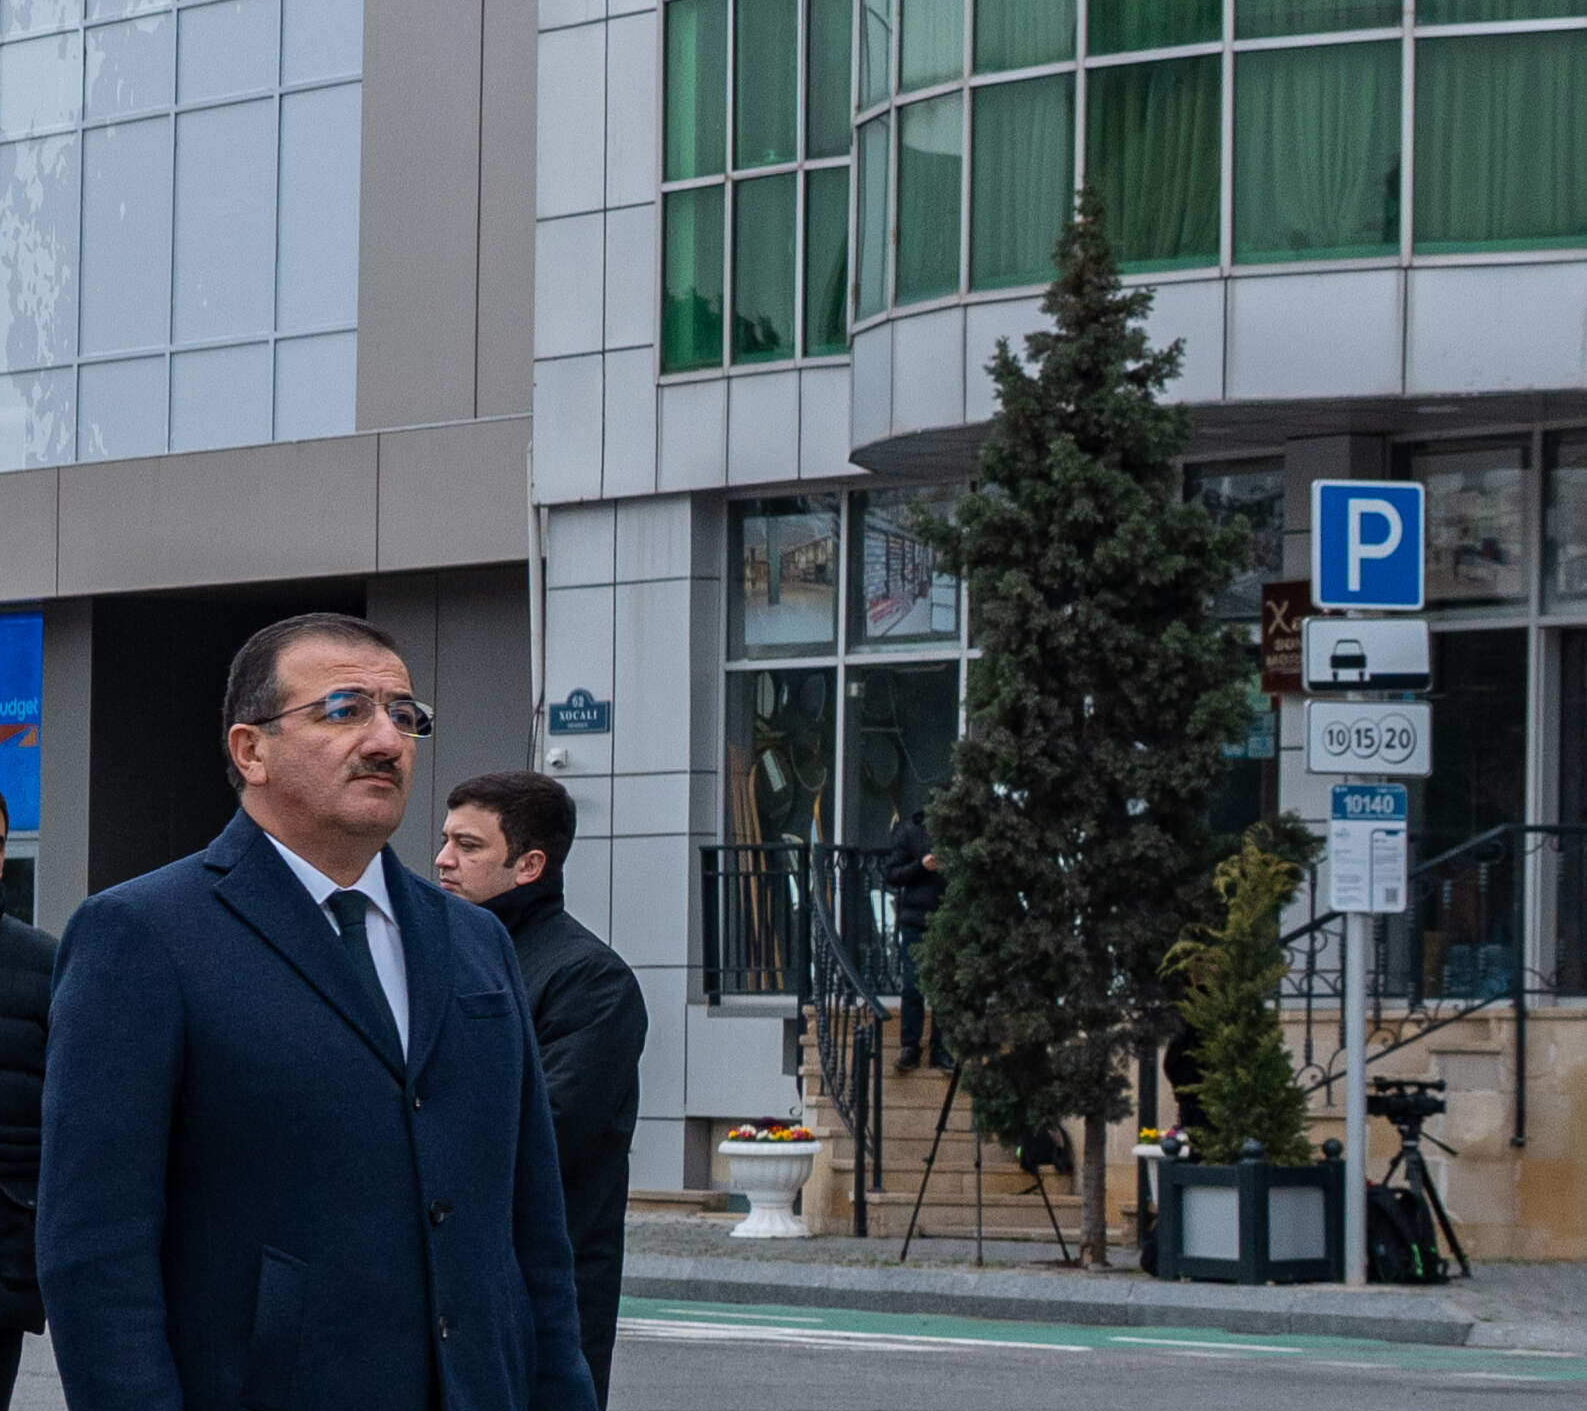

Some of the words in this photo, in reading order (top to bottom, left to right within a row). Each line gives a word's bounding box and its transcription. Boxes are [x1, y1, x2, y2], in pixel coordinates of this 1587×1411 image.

[1348, 498, 1402, 591] P
[1328, 729, 1346, 746] 10
[1355, 728, 1375, 749] 15
[1385, 728, 1411, 749] 20
[1344, 794, 1395, 814] 10140
